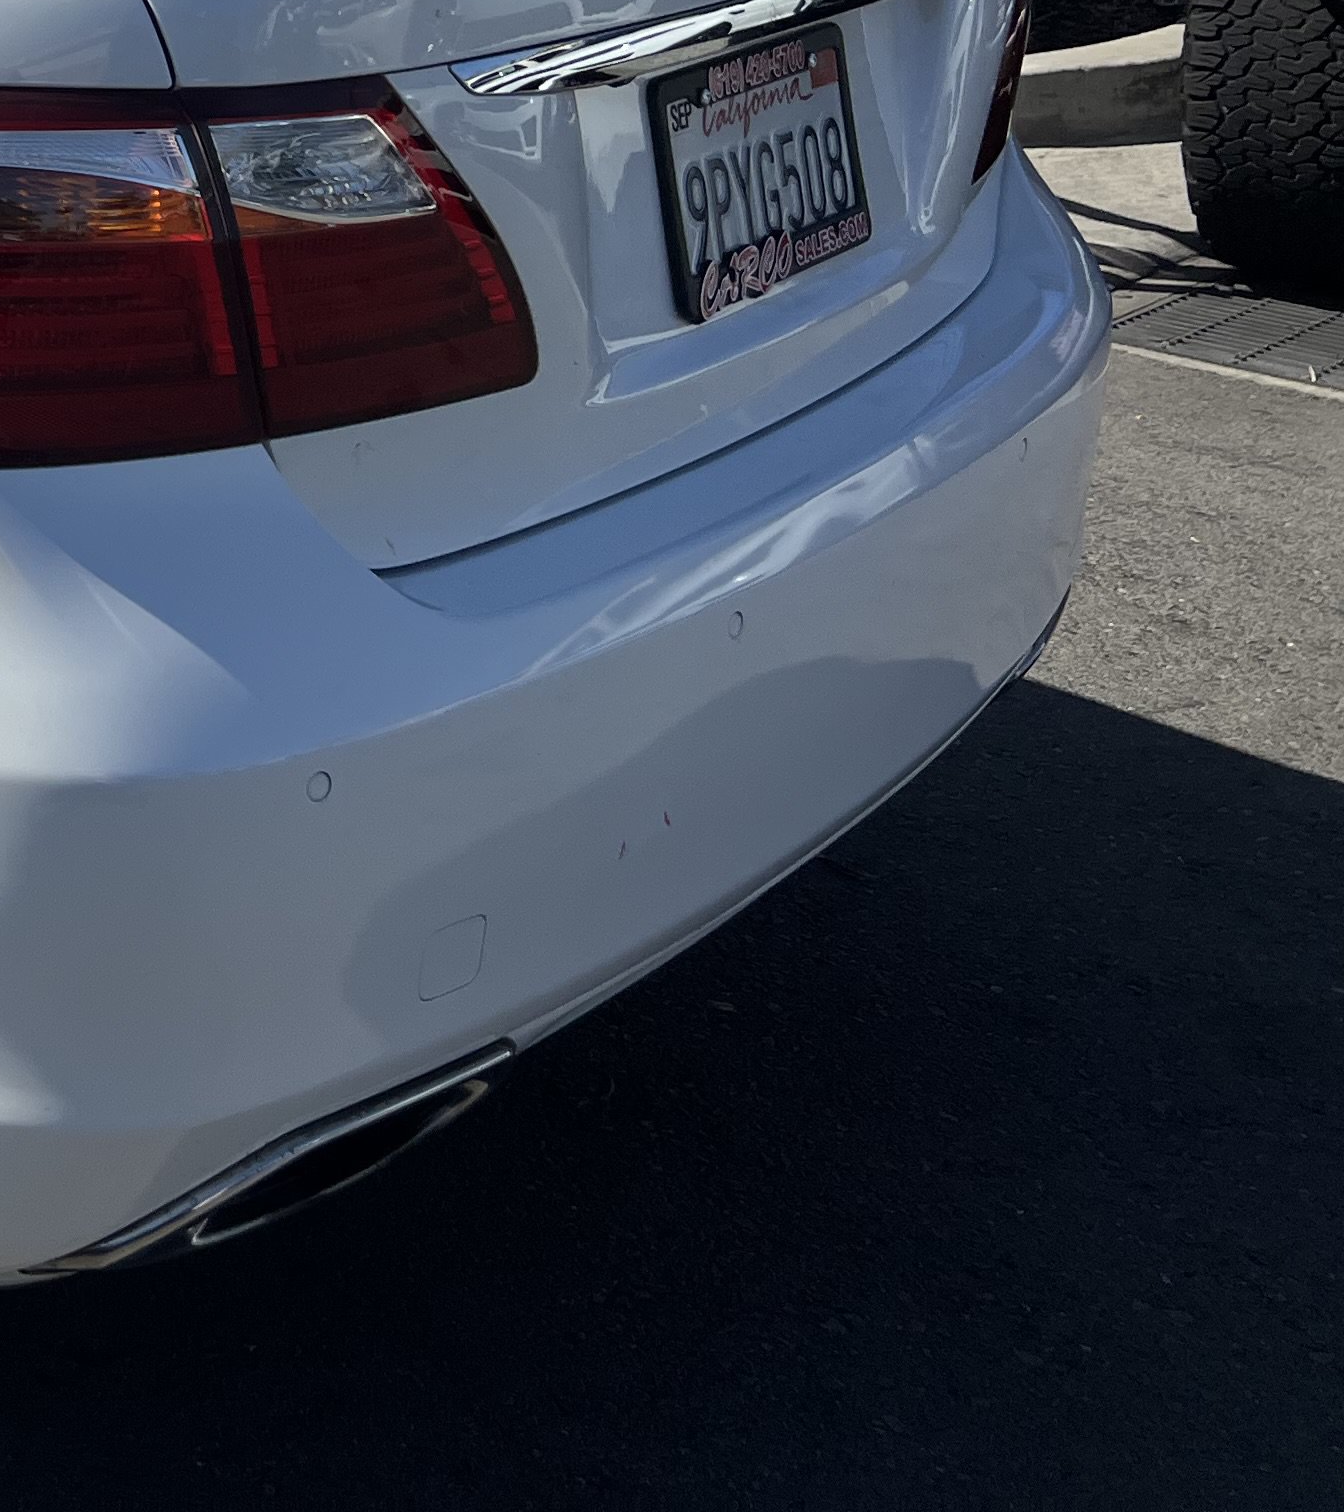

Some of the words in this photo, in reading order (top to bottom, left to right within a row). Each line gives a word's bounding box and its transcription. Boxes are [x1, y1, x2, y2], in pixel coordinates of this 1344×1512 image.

[670, 102, 692, 133] SEP
[702, 77, 814, 138] California
[683, 116, 850, 274] 9PYG508
